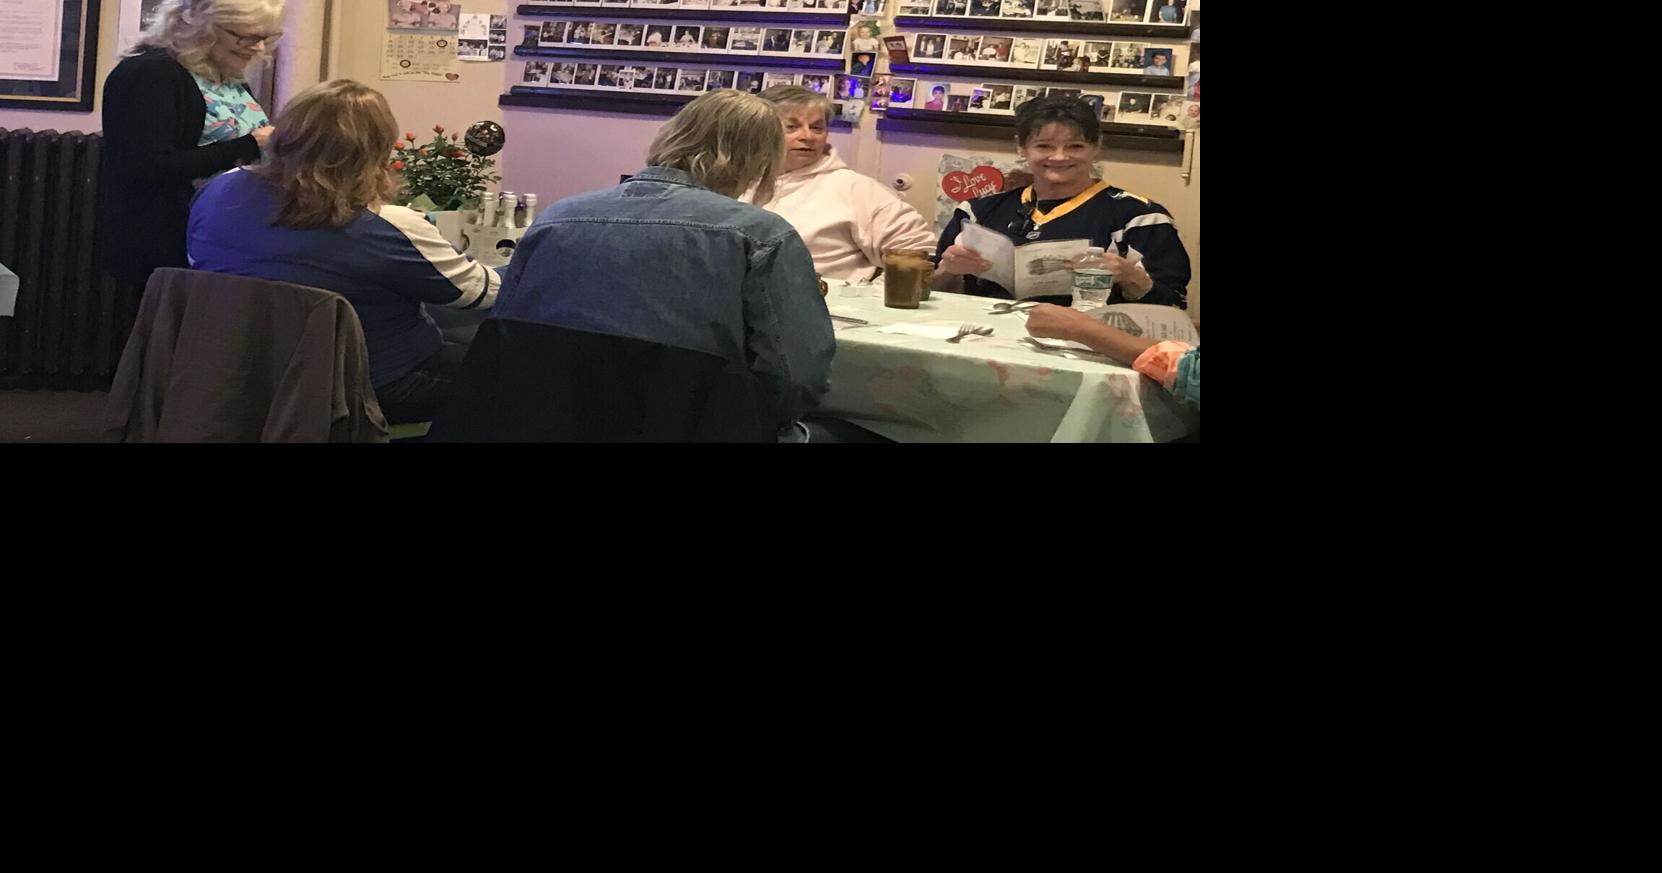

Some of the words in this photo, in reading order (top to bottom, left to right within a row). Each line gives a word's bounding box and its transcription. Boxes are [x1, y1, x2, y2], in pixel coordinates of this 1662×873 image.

[950, 176, 962, 193] I
[963, 174, 987, 193] Love
[972, 182, 997, 198] Lucy
